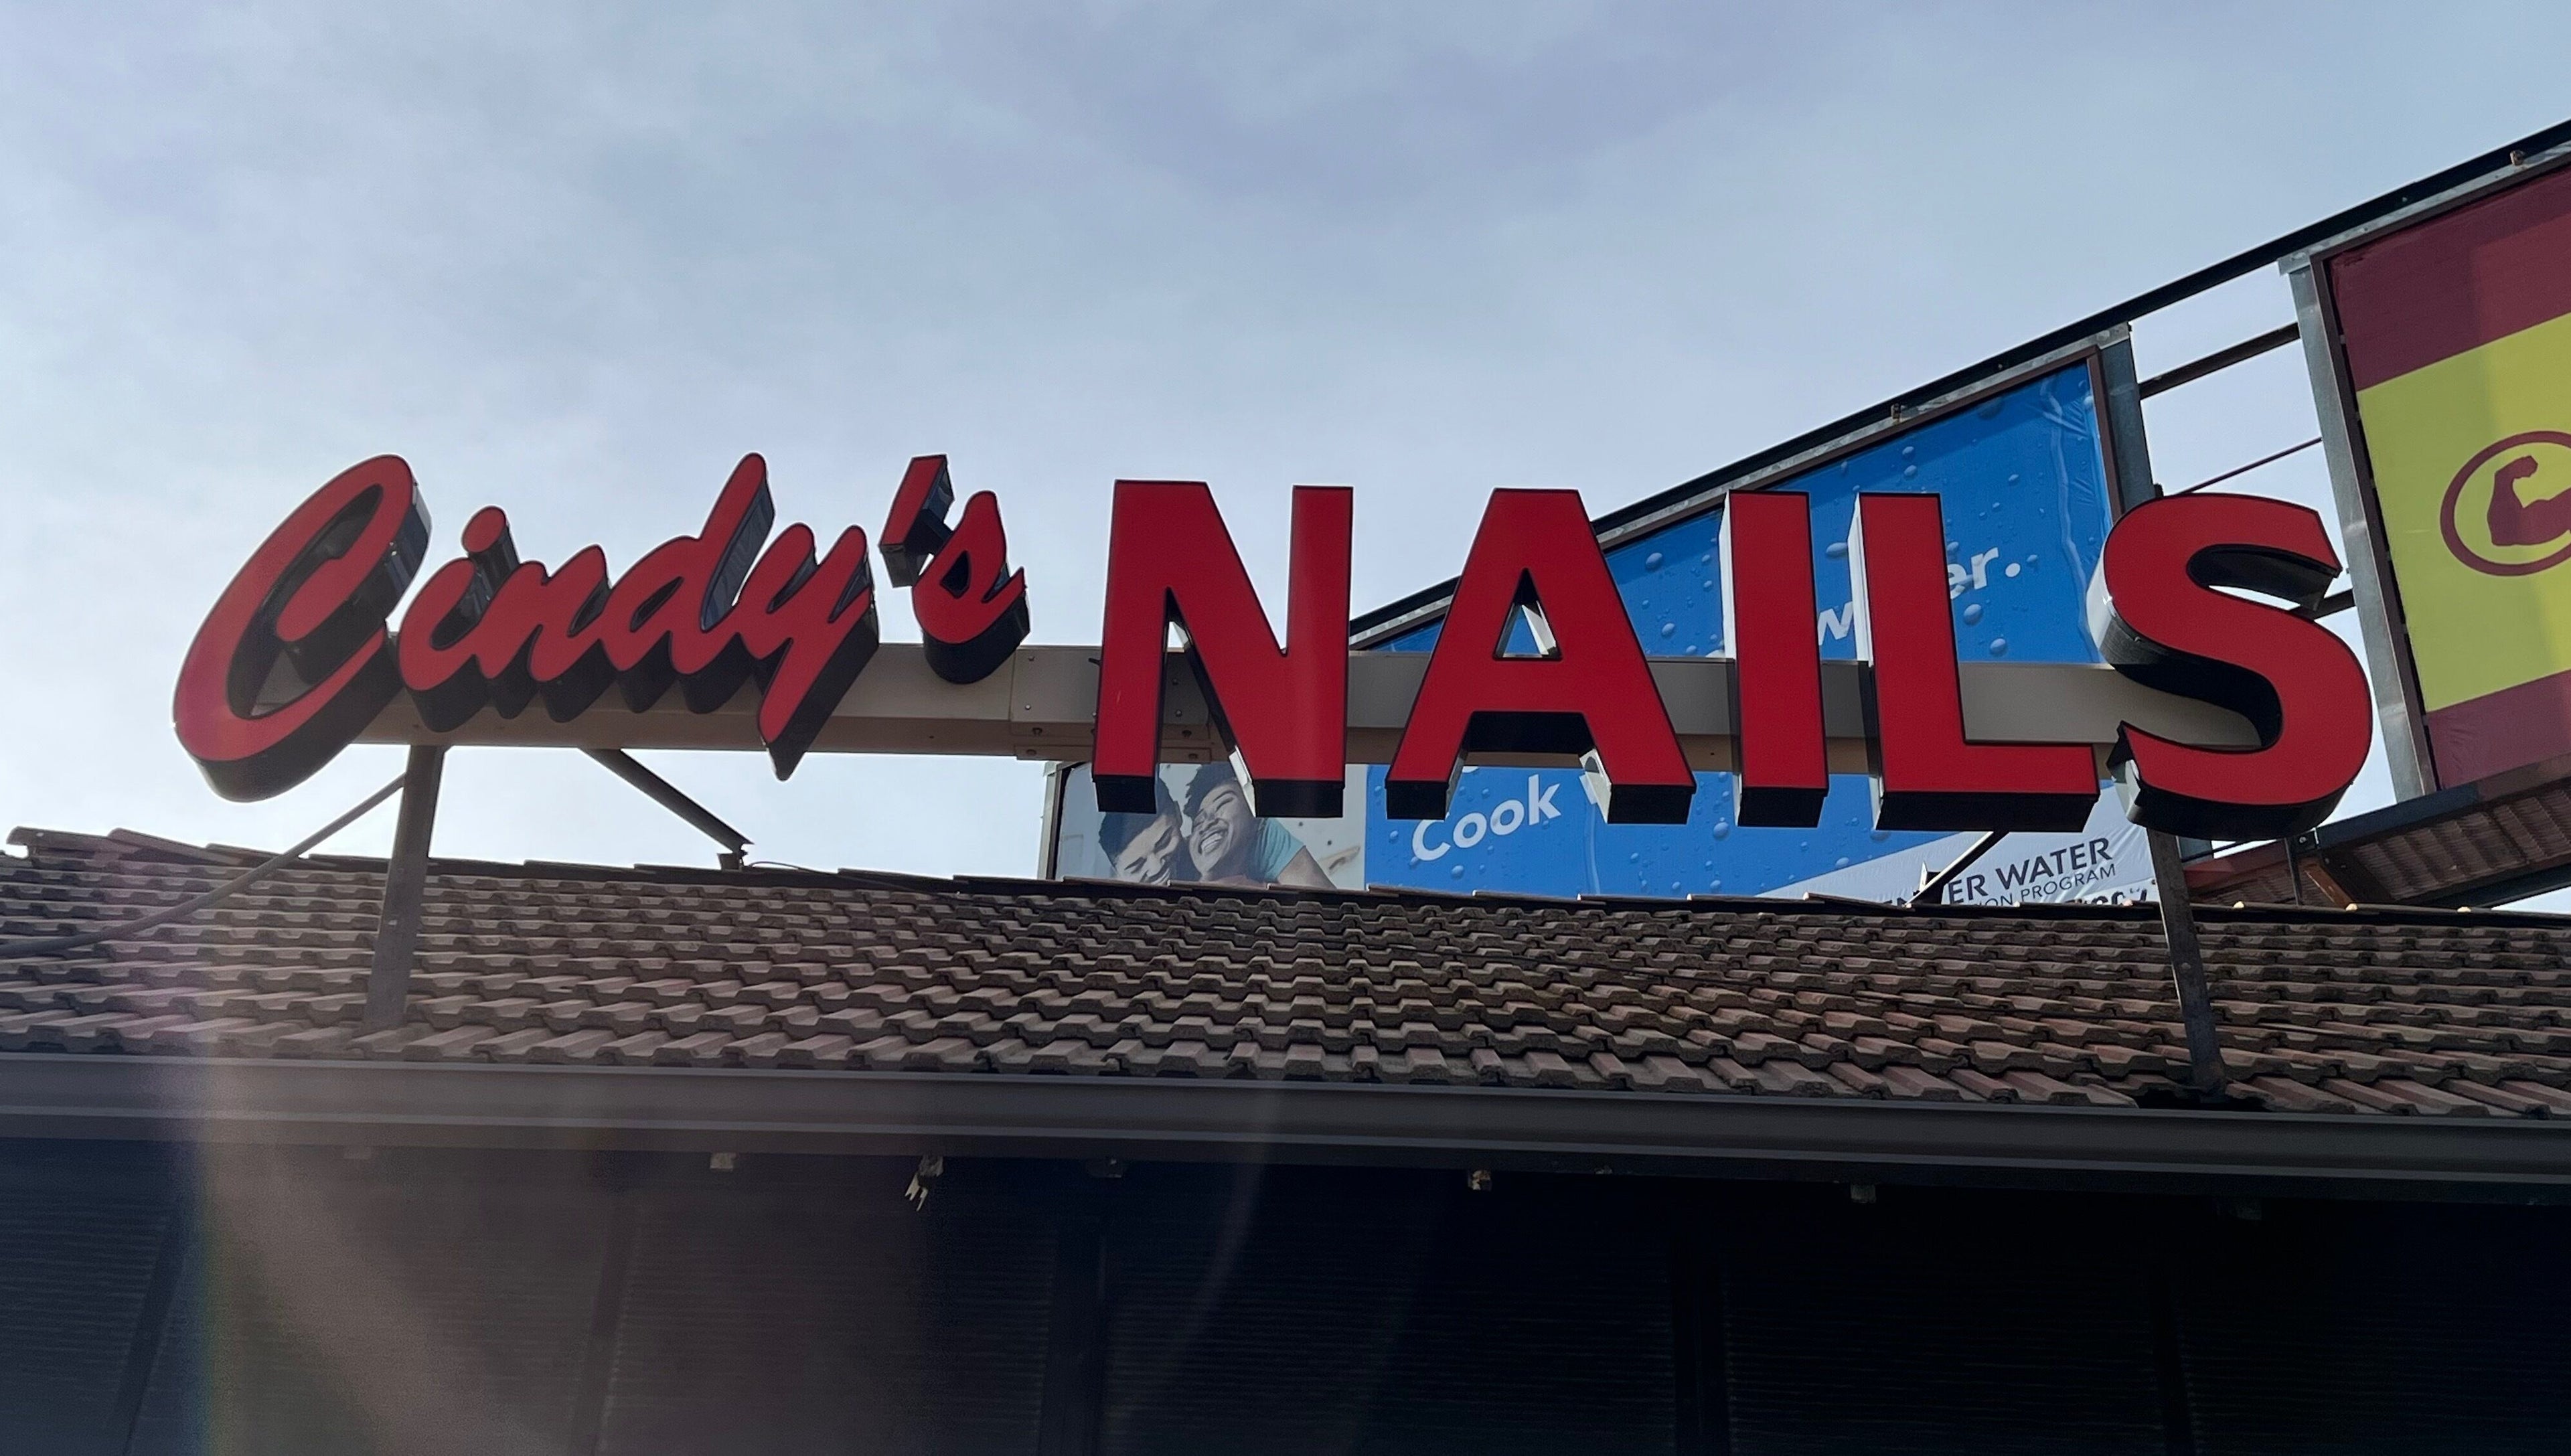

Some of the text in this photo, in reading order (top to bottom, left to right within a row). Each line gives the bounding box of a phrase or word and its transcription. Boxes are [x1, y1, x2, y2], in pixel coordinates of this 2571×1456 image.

[173, 453, 2371, 805] Cindy's NAILS
[1411, 774, 1561, 862] Cook
[1995, 837, 2112, 890] WATER
[2021, 864, 2115, 902] PROGRAM
